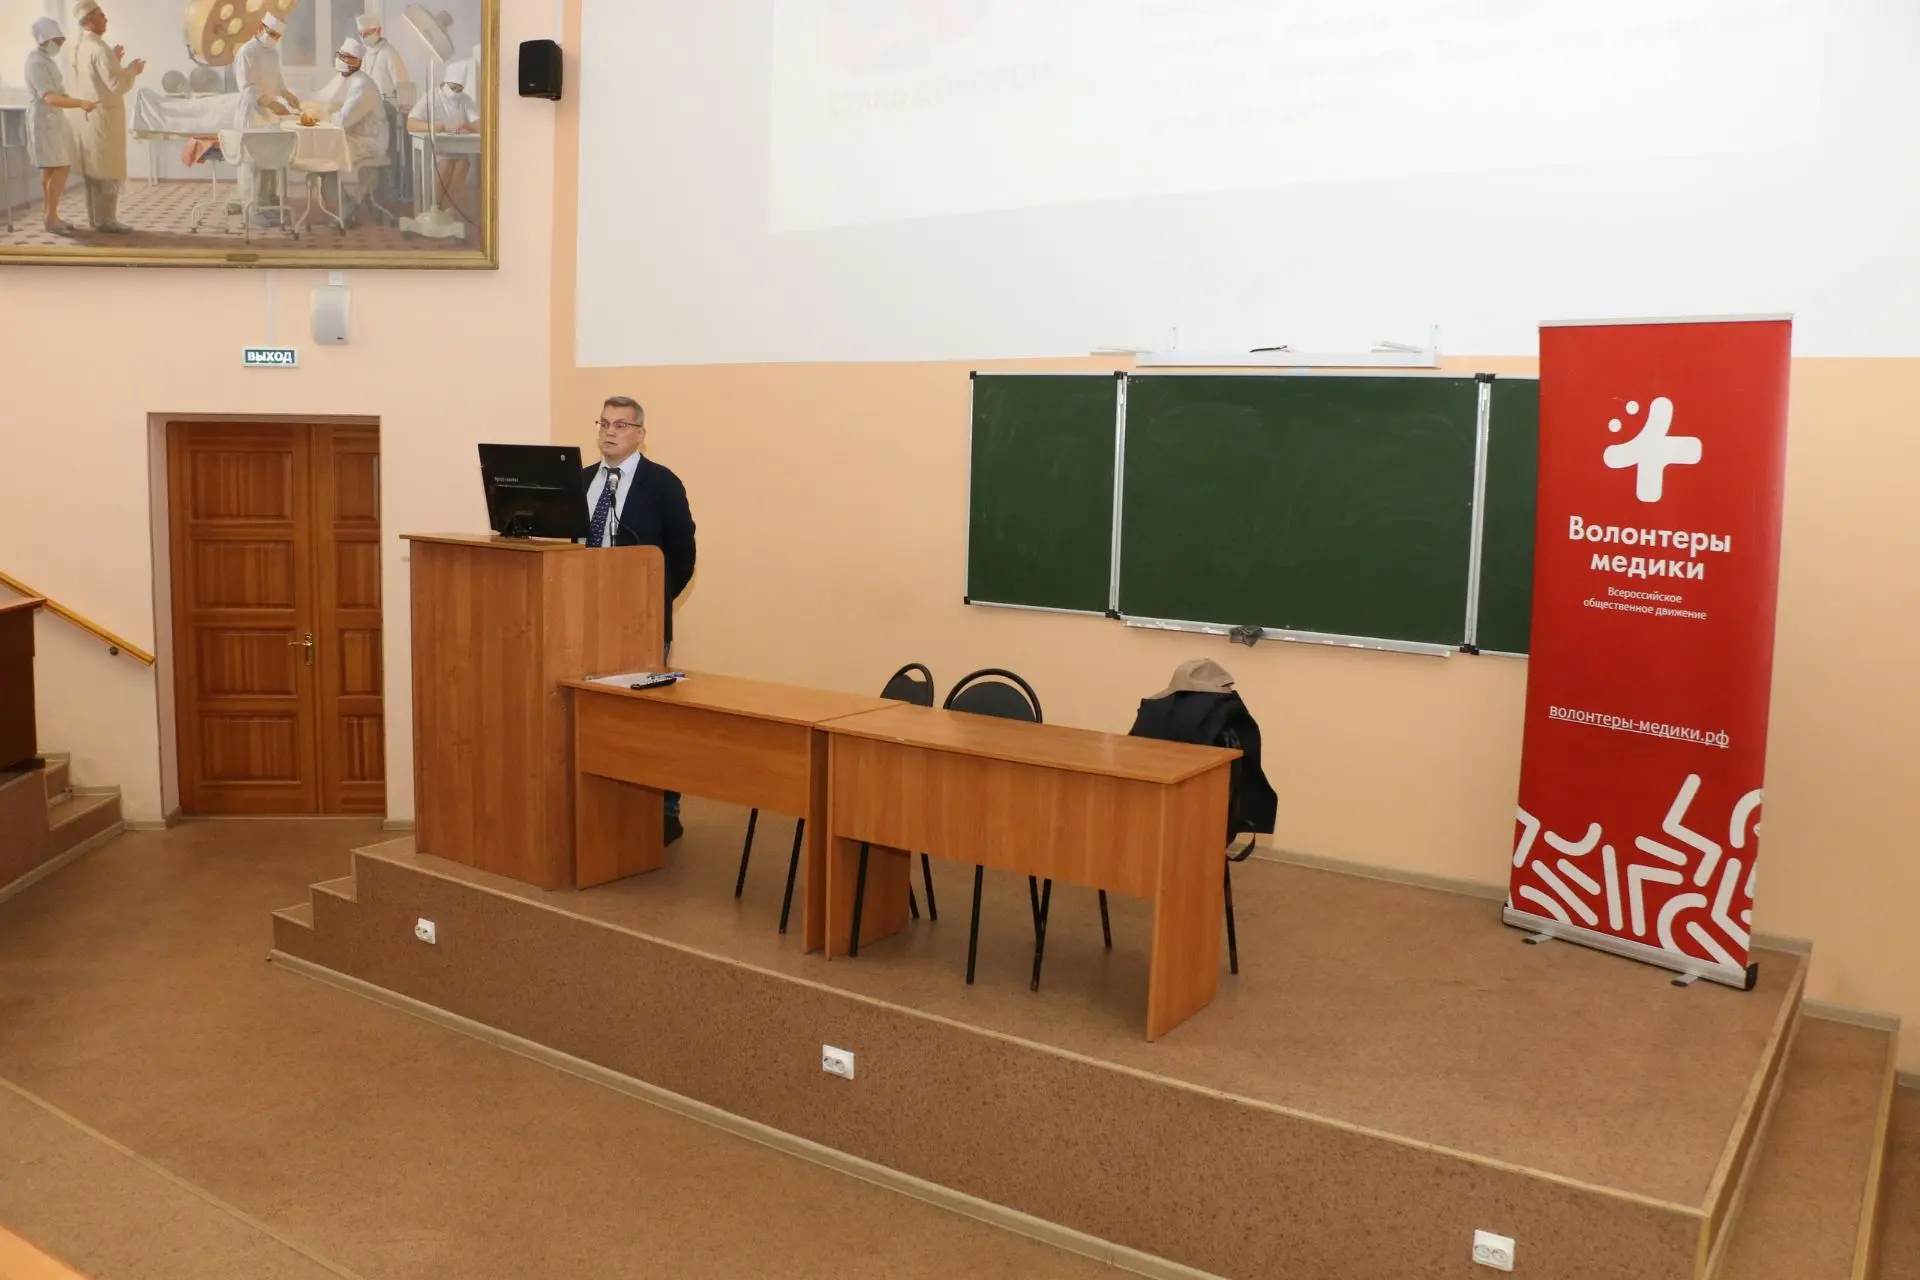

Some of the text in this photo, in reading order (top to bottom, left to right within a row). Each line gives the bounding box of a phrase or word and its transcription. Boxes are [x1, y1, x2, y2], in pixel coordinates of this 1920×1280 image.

[247, 351, 293, 363] ВЫХОД
[1568, 515, 1732, 558] Волонтеры
[1590, 553, 1705, 580] медики
[1608, 586, 1683, 604] Всероссийское
[1583, 597, 1707, 620] общественное движение
[1549, 705, 1730, 748] волонтеры-медики.рф
